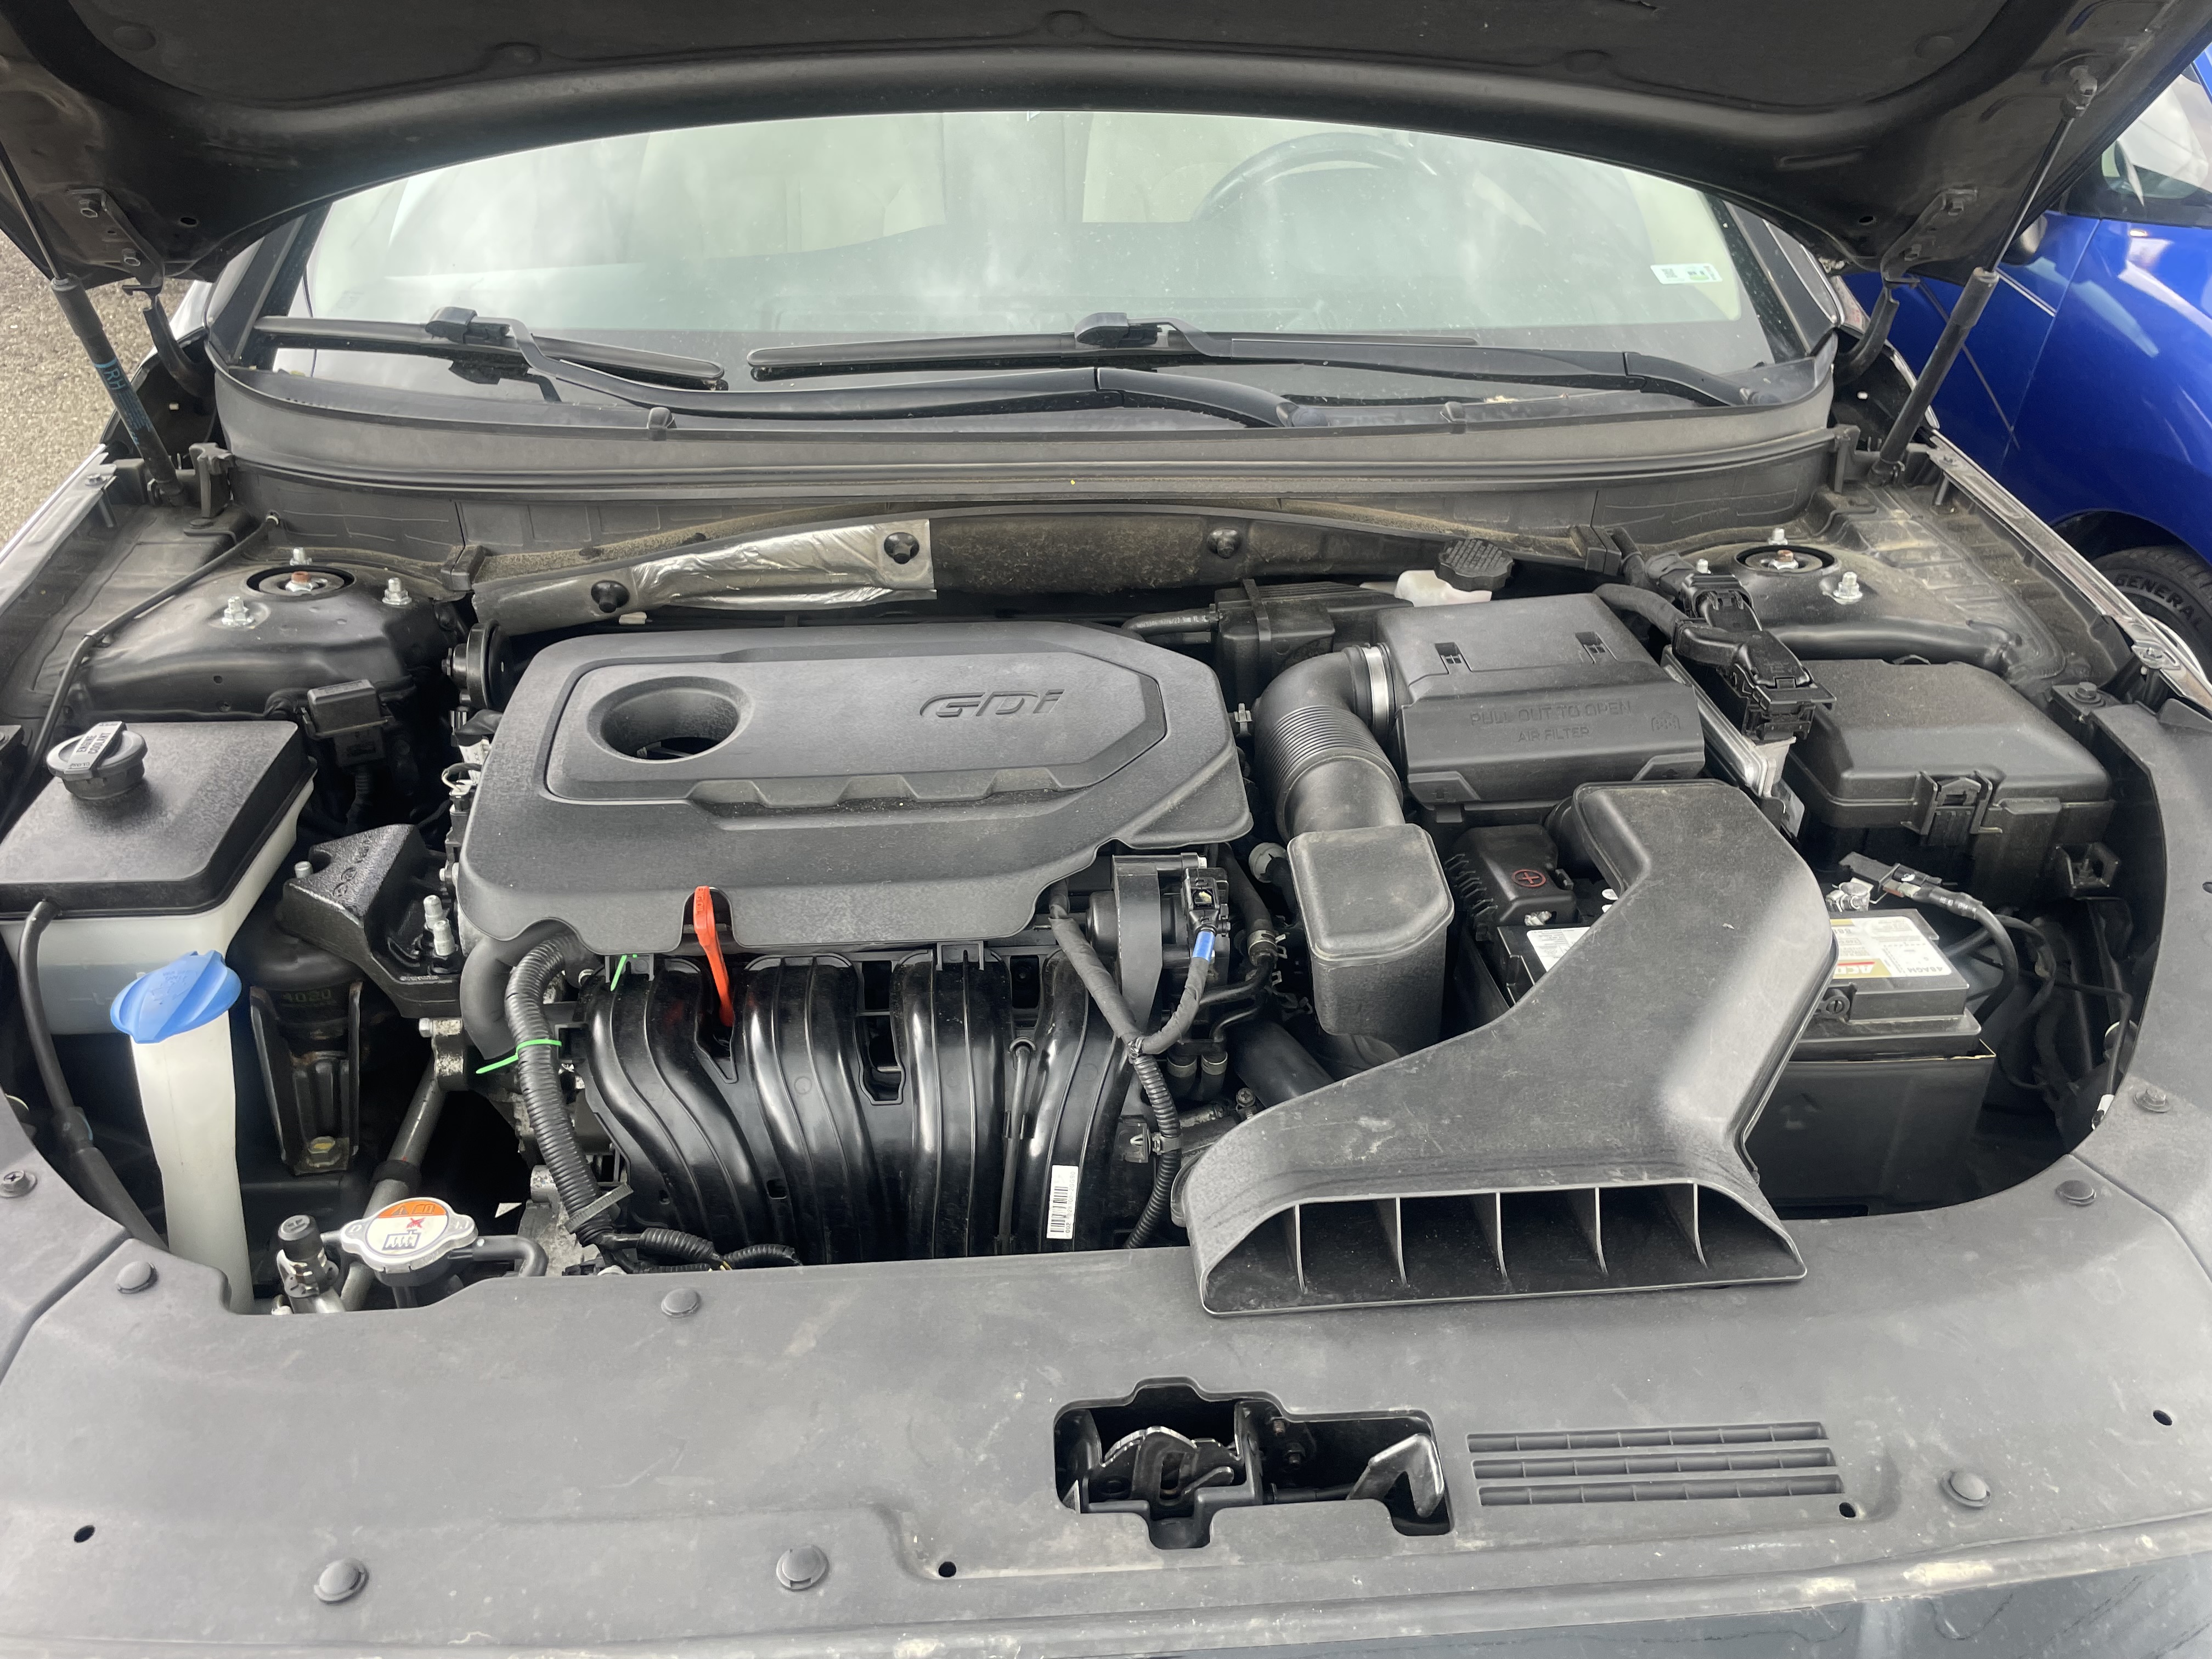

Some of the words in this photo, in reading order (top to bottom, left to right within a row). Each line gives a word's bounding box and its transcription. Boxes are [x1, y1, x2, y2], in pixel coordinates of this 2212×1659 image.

[104, 368, 126, 390] RH
[2114, 573, 2206, 630] GENERAL
[1471, 711, 1512, 725] PULL
[1518, 707, 1552, 722] OUT
[1558, 705, 1581, 719] TO
[1585, 701, 1633, 716] OPEN
[88, 733, 111, 754] COOLANT
[1518, 729, 1540, 742] AIR
[1545, 726, 1590, 741] FILTER
